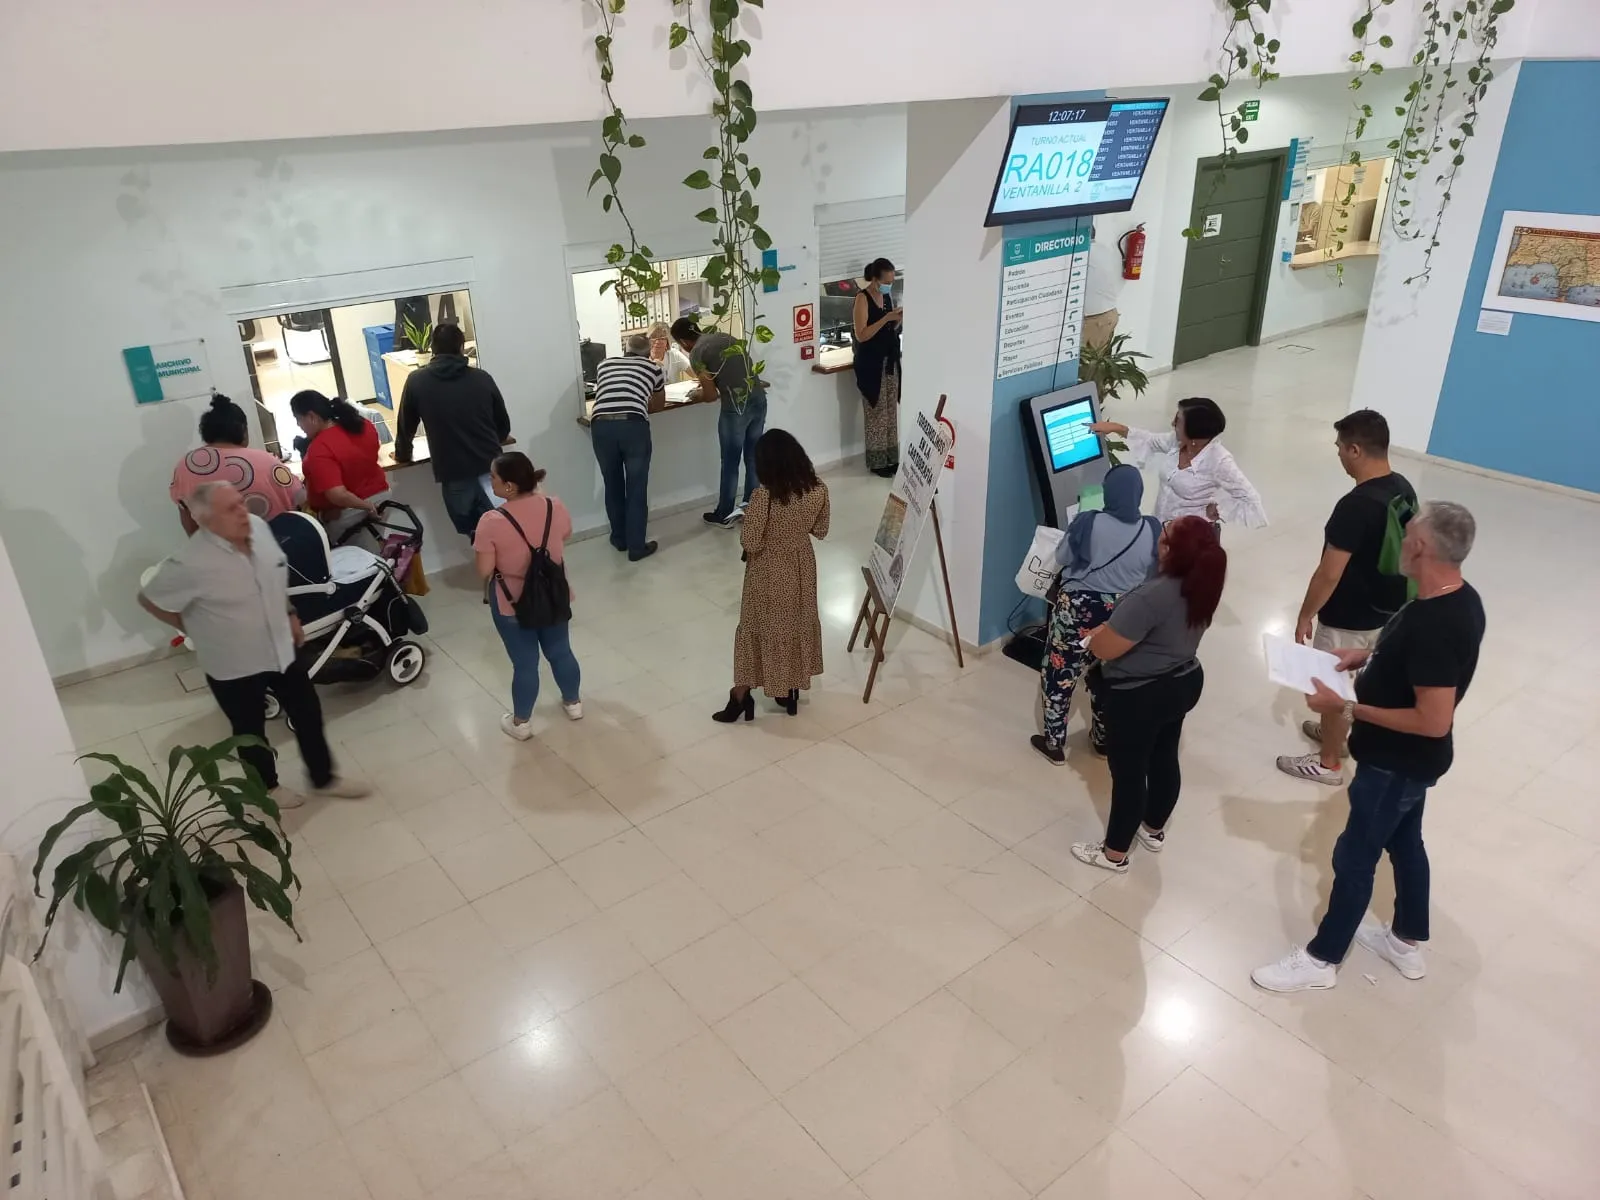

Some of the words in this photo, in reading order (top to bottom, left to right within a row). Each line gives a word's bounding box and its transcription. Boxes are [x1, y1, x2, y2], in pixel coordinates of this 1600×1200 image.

[1048, 110, 1086, 122] 12:07:17
[1032, 136, 1058, 146] TURNO
[1058, 134, 1086, 144] ACTUAL
[1004, 148, 1094, 184] RA018
[1002, 182, 1070, 199] VENTANILLA
[1074, 181, 1083, 193] 2
[1034, 234, 1084, 254] DIRECTORIO
[1008, 268, 1026, 278] Padrón
[1008, 282, 1030, 292] Hacienda
[1006, 292, 1038, 306] Participación
[1038, 288, 1062, 299] Ciudadana
[1006, 311, 1024, 320] Eventos
[1004, 324, 1030, 335] Educación
[1004, 338, 1026, 348] Deportes
[156, 358, 192, 369] ARCHIVO
[158, 366, 202, 378] MUNICIPAL
[1002, 365, 1023, 376] Servicios
[917, 410, 946, 456] TORREMOLINOS
[918, 436, 926, 452] EN
[924, 443, 932, 460] LA
[908, 442, 934, 486] CARTOGRAFÍA
